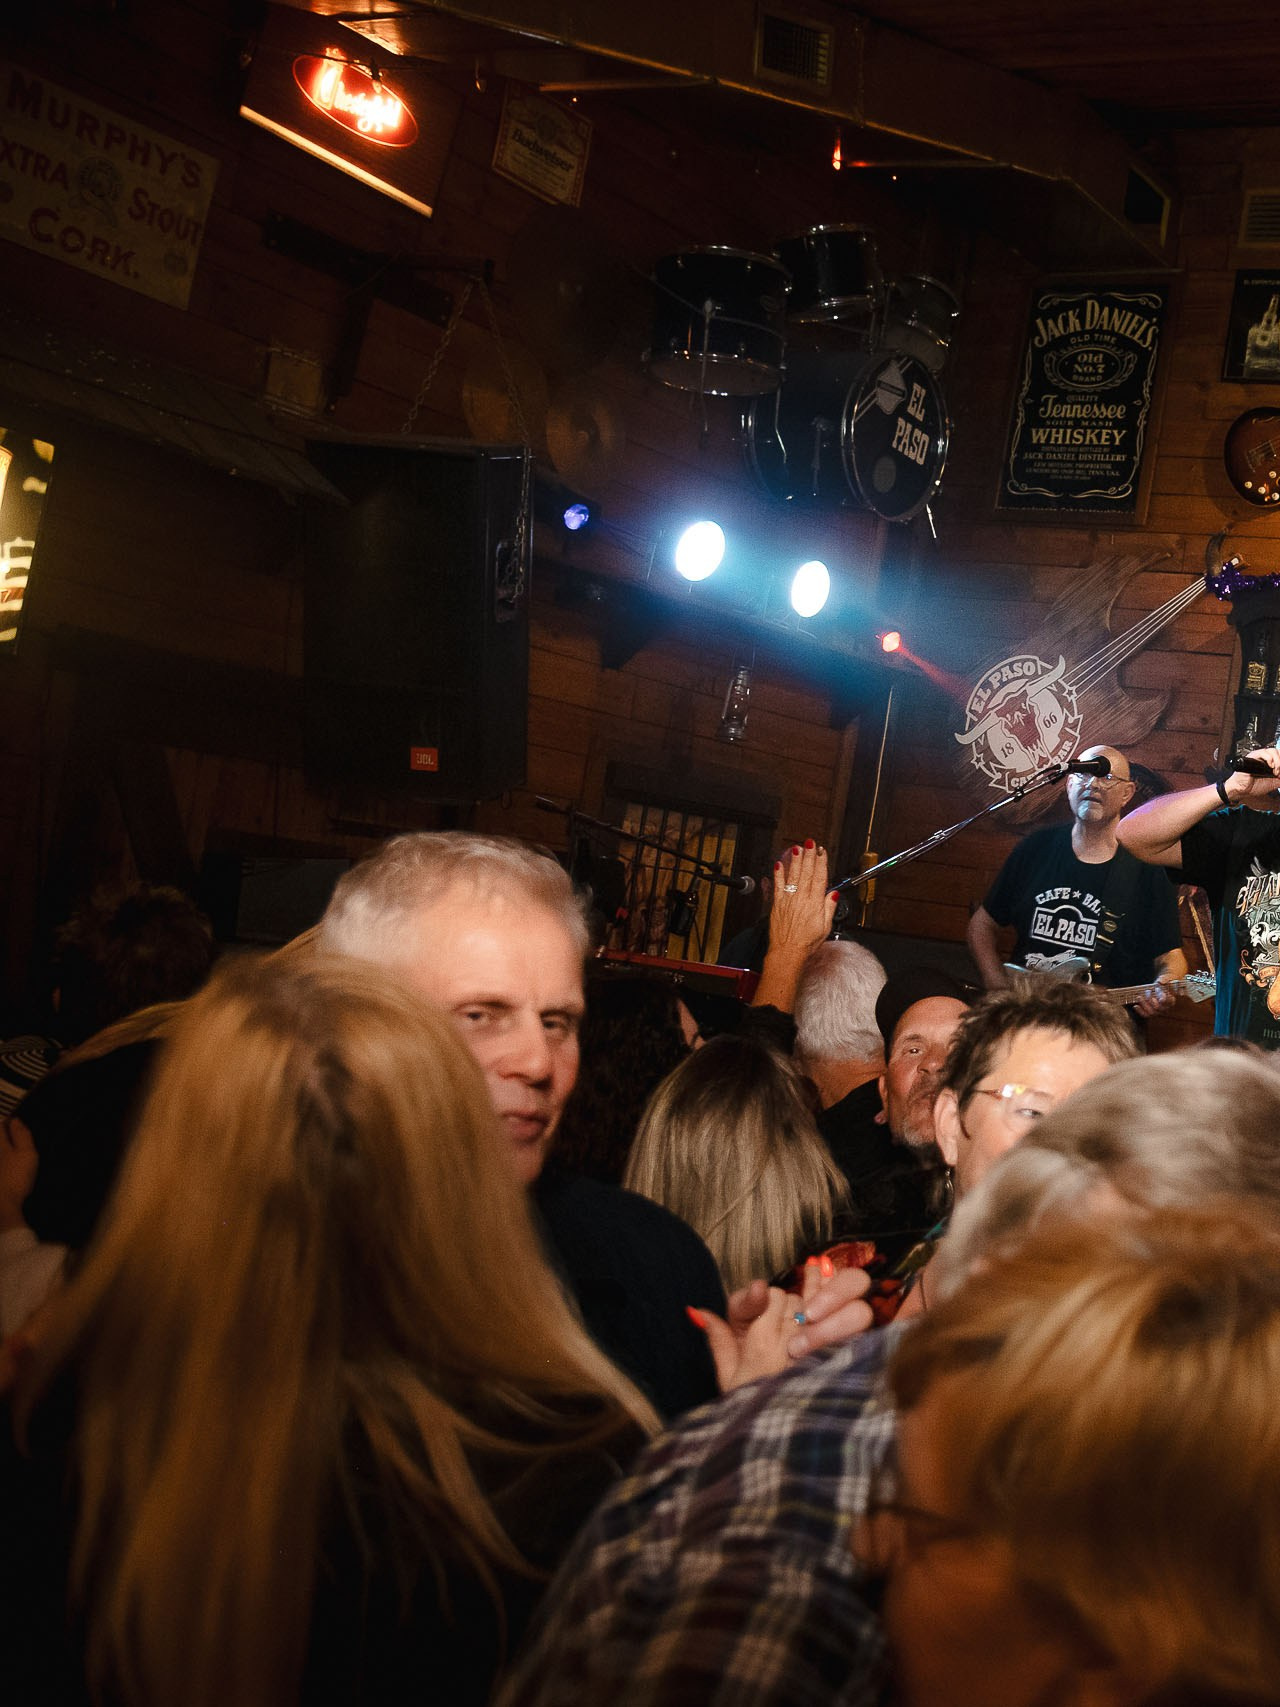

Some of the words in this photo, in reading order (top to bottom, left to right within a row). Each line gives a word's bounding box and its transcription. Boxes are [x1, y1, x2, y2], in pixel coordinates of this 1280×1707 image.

[7, 69, 202, 188] MURPHY'S
[0, 136, 69, 191] XTRA
[512, 127, 575, 172] Budweiser
[1034, 307, 1082, 348] JACK
[1085, 299, 1159, 351] DANIEL'S
[1070, 334, 1090, 344] OLD
[1094, 333, 1117, 344] TIME
[1077, 352, 1103, 363] Old
[907, 382, 927, 422] EL
[1039, 393, 1126, 419] Tennessee
[891, 416, 930, 466] PASO
[1030, 427, 1128, 446] WHISKEY
[971, 688, 991, 714] EL
[988, 661, 1036, 690] PASO
[1034, 887, 1072, 905] CAFE
[1081, 893, 1102, 917] BA
[1033, 913, 1055, 937] EL
[1054, 918, 1097, 946] PASO
